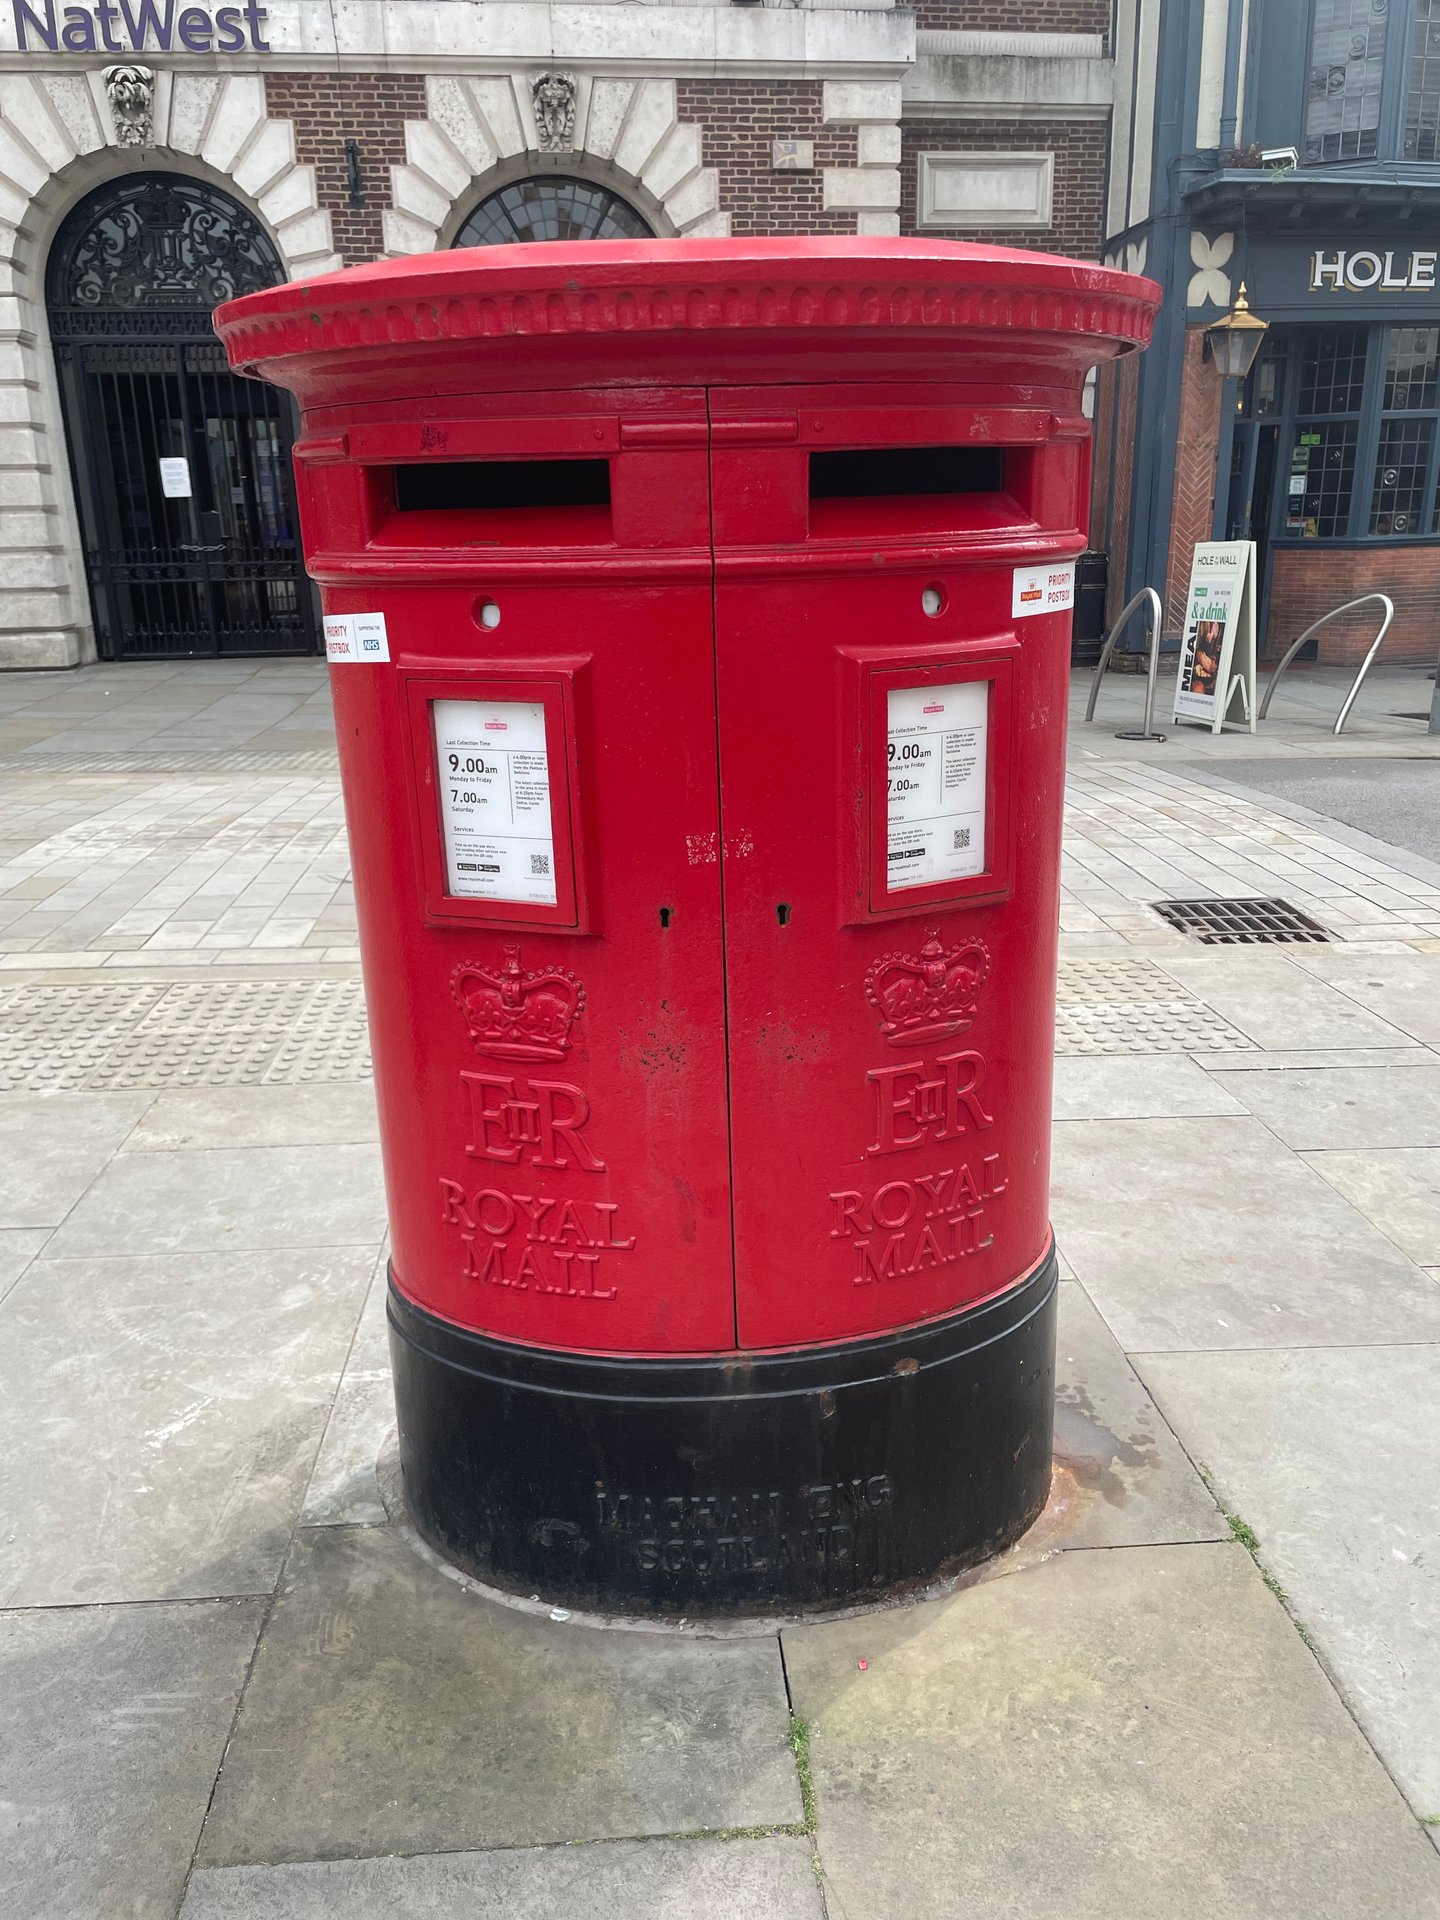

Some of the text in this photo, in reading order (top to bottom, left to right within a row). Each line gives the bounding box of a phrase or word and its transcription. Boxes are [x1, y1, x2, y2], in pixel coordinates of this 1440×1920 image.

[11, 0, 270, 51] NatWest
[1308, 250, 1437, 291] HOLE
[1197, 556, 1214, 565] HOLE
[1219, 555, 1237, 565] WALL
[1048, 573, 1071, 586] PRIORITY
[1047, 590, 1070, 603] POSTBOX
[1192, 601, 1228, 621] & a drink
[364, 640, 379, 650] NHS
[1181, 621, 1198, 692] MEAL
[448, 753, 498, 774] 9.00am
[888, 743, 932, 762] 9.00am
[450, 789, 488, 804] 7.00am
[829, 1153, 1008, 1239] ROYAL
[439, 1177, 636, 1250] ROYAL
[853, 1208, 994, 1286] MAIL
[461, 1233, 618, 1300] MAIL
[637, 1525, 850, 1571] SCOTLAND
